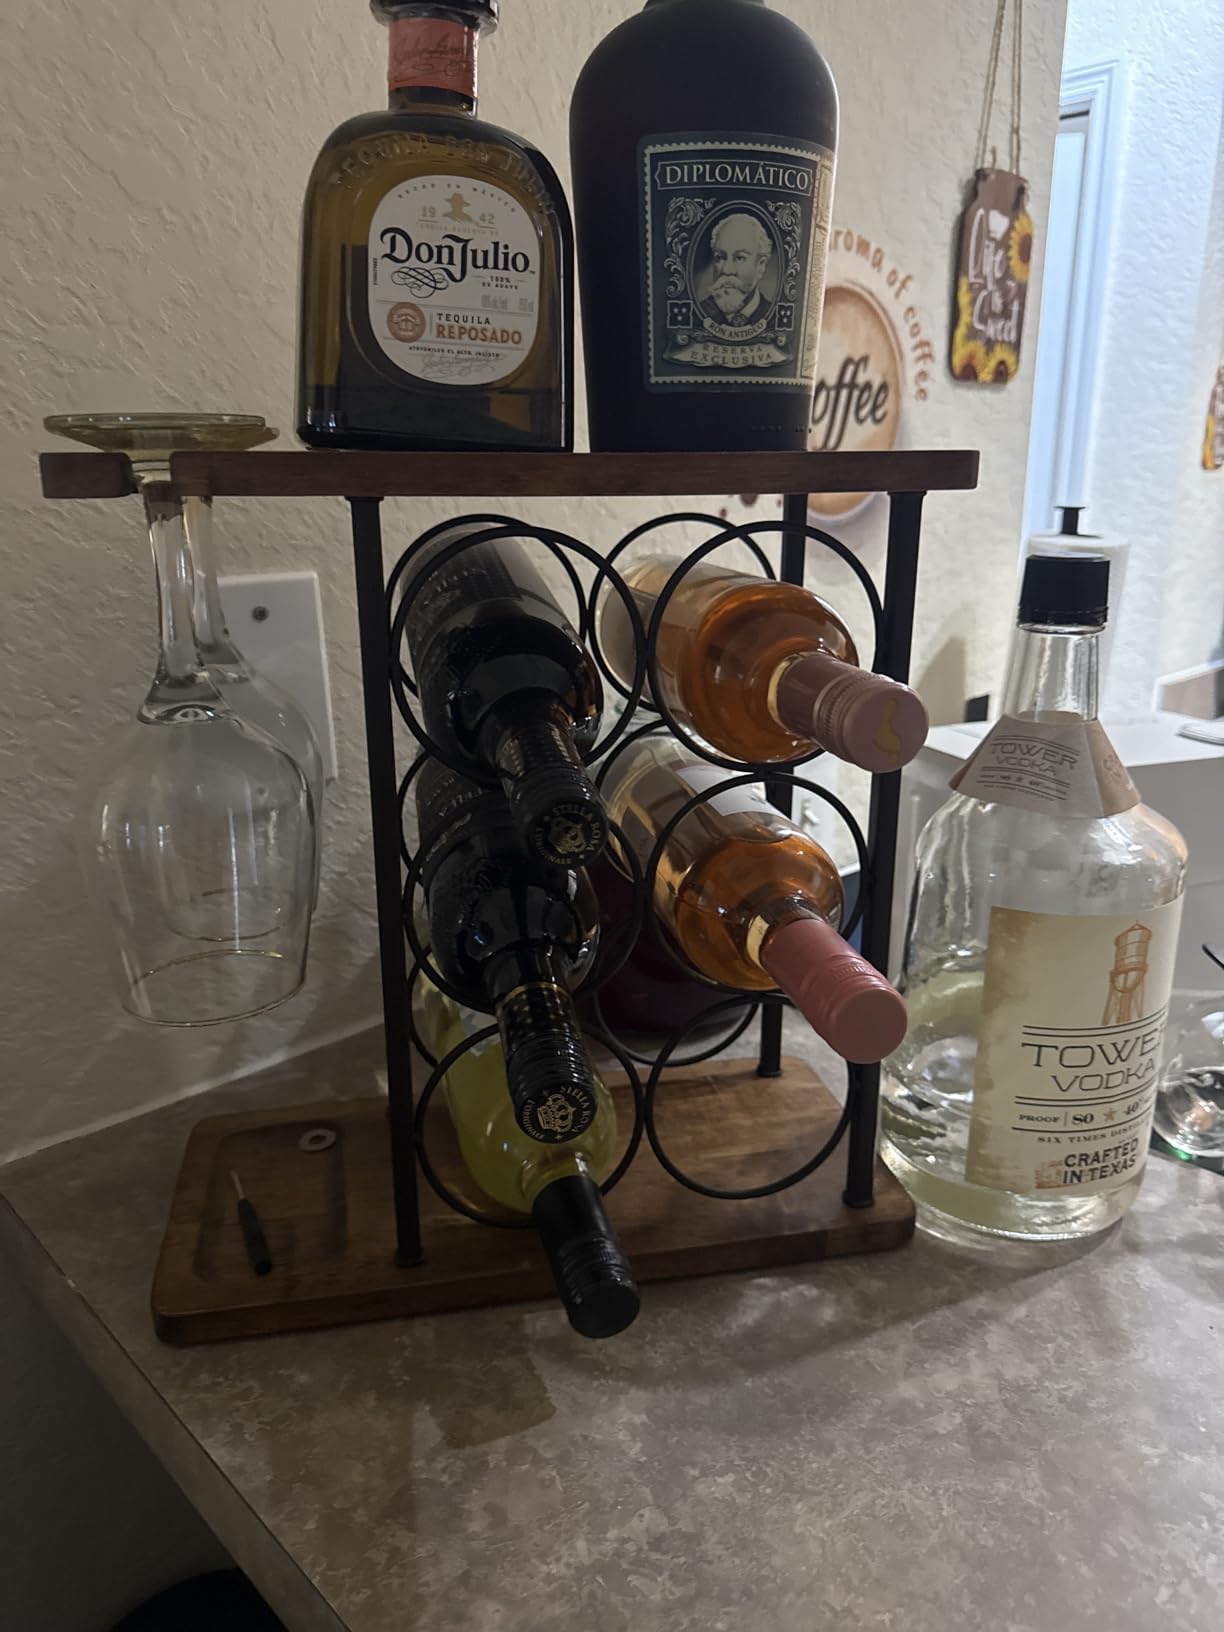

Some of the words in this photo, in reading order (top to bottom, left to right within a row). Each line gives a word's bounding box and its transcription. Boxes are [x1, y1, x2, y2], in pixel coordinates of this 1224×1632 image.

[665, 161, 810, 191] DIPLOMÁTICO
[380, 227, 457, 267] Don
[436, 312, 492, 326] TEQUILA
[708, 321, 727, 337] RON
[435, 323, 523, 346] REPOSADO
[886, 268, 914, 300] of
[903, 305, 935, 402] coffee
[690, 351, 772, 366] EXCLUSIVA
[811, 354, 889, 451] offee
[990, 741, 1078, 770] TOWER
[996, 756, 1057, 777] VODKA
[1051, 1058, 1156, 1092] VODKA
[1018, 1114, 1060, 1124] PROOF
[1072, 1113, 1095, 1126] 80
[1037, 1136, 1062, 1144] SIX
[1068, 1133, 1107, 1144] TIMES
[1064, 1137, 1139, 1168] CRAFTED
[1063, 1169, 1083, 1184] IN
[1088, 1153, 1137, 1182] TEXAS
